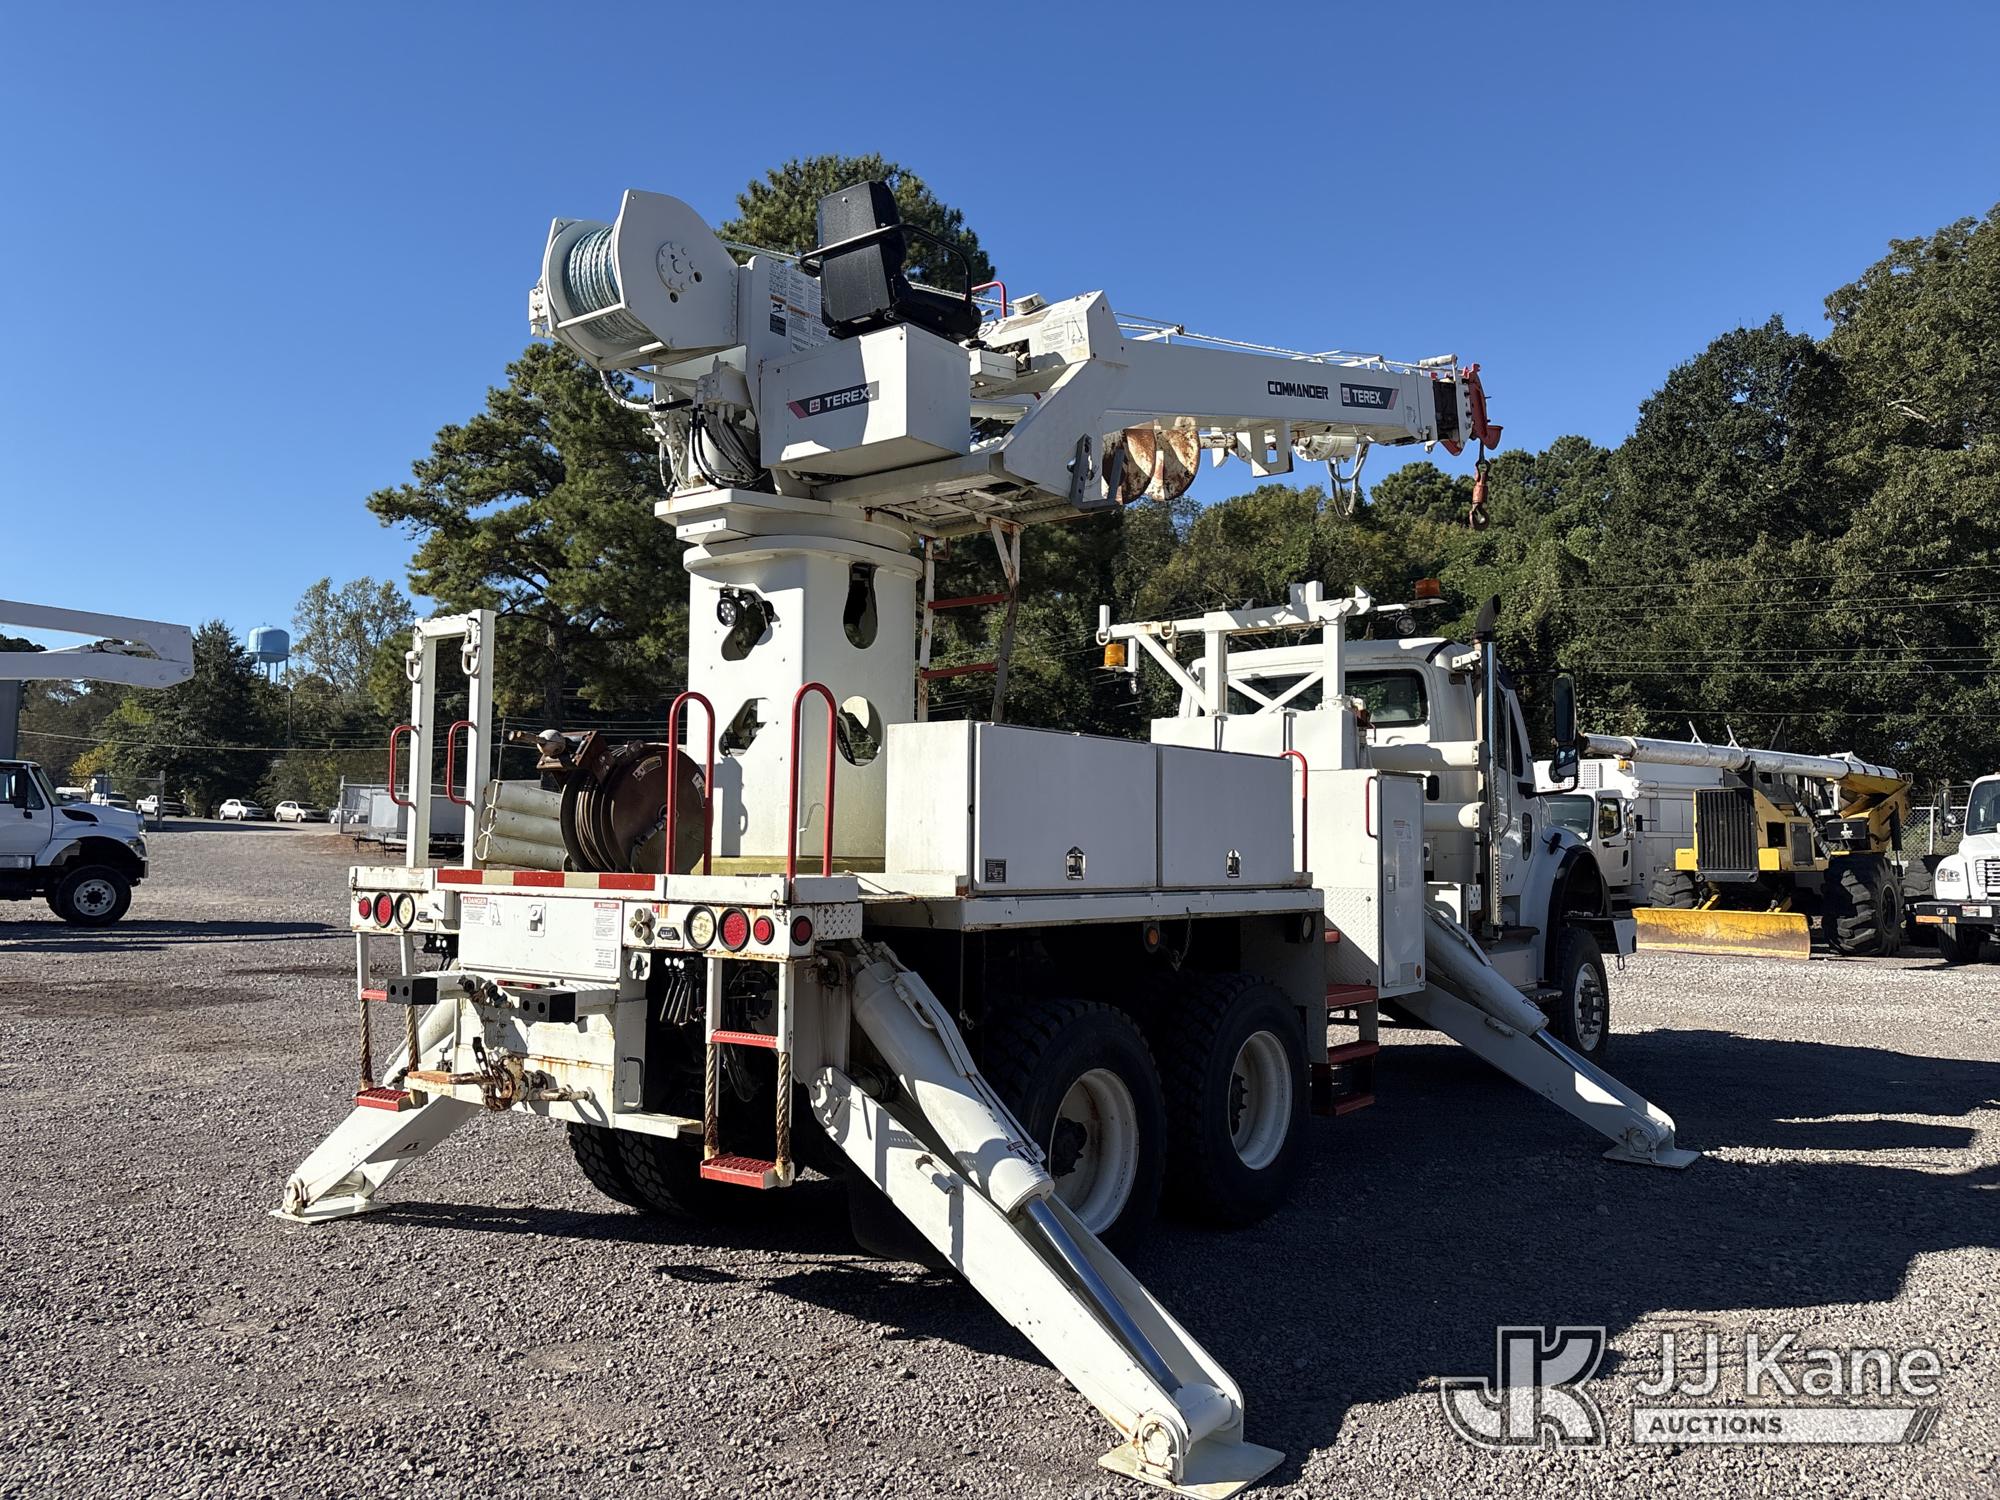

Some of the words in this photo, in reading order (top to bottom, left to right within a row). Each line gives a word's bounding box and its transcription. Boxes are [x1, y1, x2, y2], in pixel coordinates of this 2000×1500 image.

[824, 387, 870, 408] TEREX
[1267, 380, 1329, 400] COMMANDER
[1352, 388, 1382, 405] TEREX
[467, 897, 487, 905] DANGER
